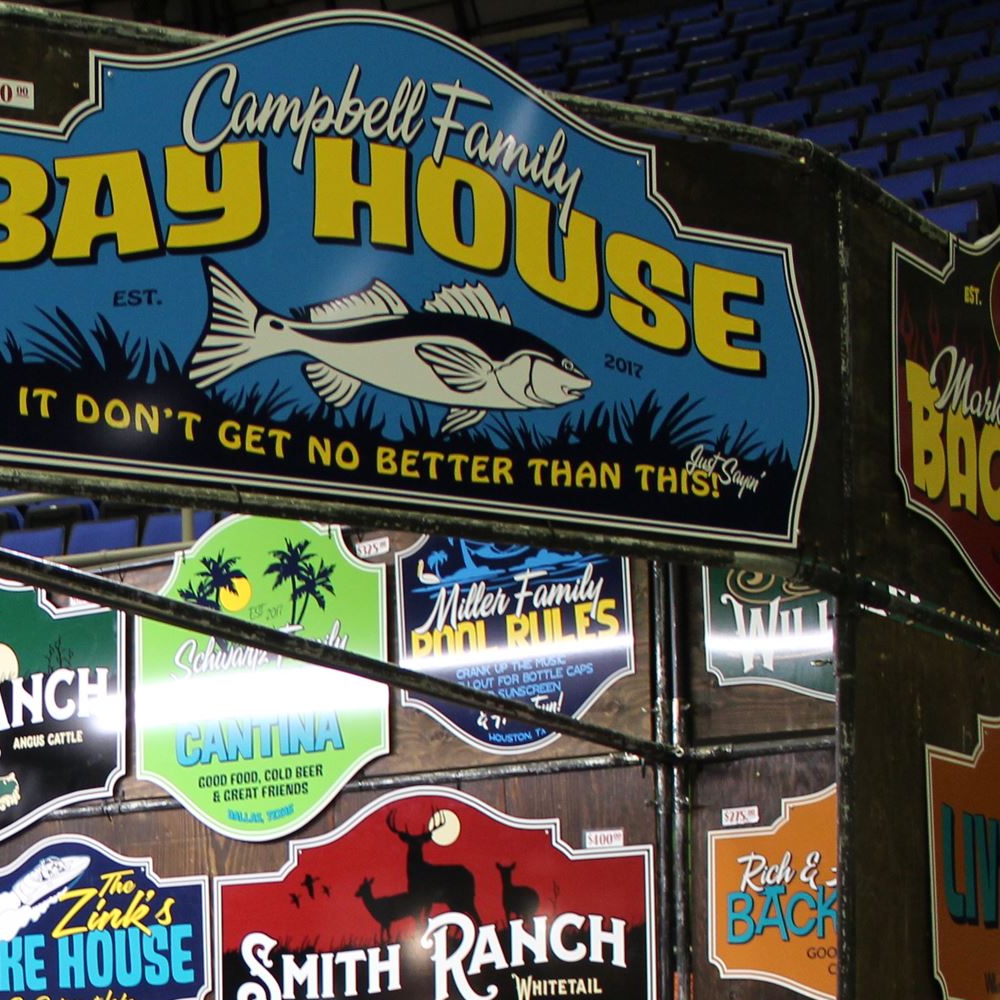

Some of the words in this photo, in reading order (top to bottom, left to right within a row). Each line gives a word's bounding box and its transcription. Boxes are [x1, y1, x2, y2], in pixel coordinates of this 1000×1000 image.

[182, 62, 424, 173] Campbell
[433, 78, 583, 233] Family
[314, 136, 765, 373] HOUSE
[113, 289, 163, 308] EST.
[604, 353, 645, 379] 2017
[18, 387, 57, 418] IT
[76, 394, 201, 442] DON'T
[218, 419, 291, 459] GET
[308, 436, 360, 470] NO
[376, 446, 514, 485] BETTER
[528, 459, 621, 491] THAN
[635, 465, 720, 499] THIS!
[685, 444, 726, 479] Just
[414, 581, 510, 634] Miller
[512, 563, 604, 619] Family
[507, 599, 621, 649] RULES
[494, 663, 508, 674] UP
[511, 660, 533, 672] THE
[535, 655, 567, 668] MUSIC
[498, 674, 519, 687] FOR
[522, 669, 563, 682] BOTTLE
[566, 662, 593, 677] CAPS
[498, 682, 562, 699] SUNSCREEN
[13, 735, 45, 750] ANGUS
[47, 730, 83, 747] CATTLE
[175, 710, 346, 768] CANTINA
[198, 772, 228, 788] GOOD
[264, 767, 293, 783] COLD
[296, 764, 323, 779] BEER
[223, 787, 260, 802] GREAT
[261, 782, 309, 799] FRIENDS
[100, 869, 137, 898] The
[737, 850, 797, 893] Rich
[800, 850, 820, 890] &
[51, 888, 175, 938] Zink's
[58, 924, 195, 990] HOUSE
